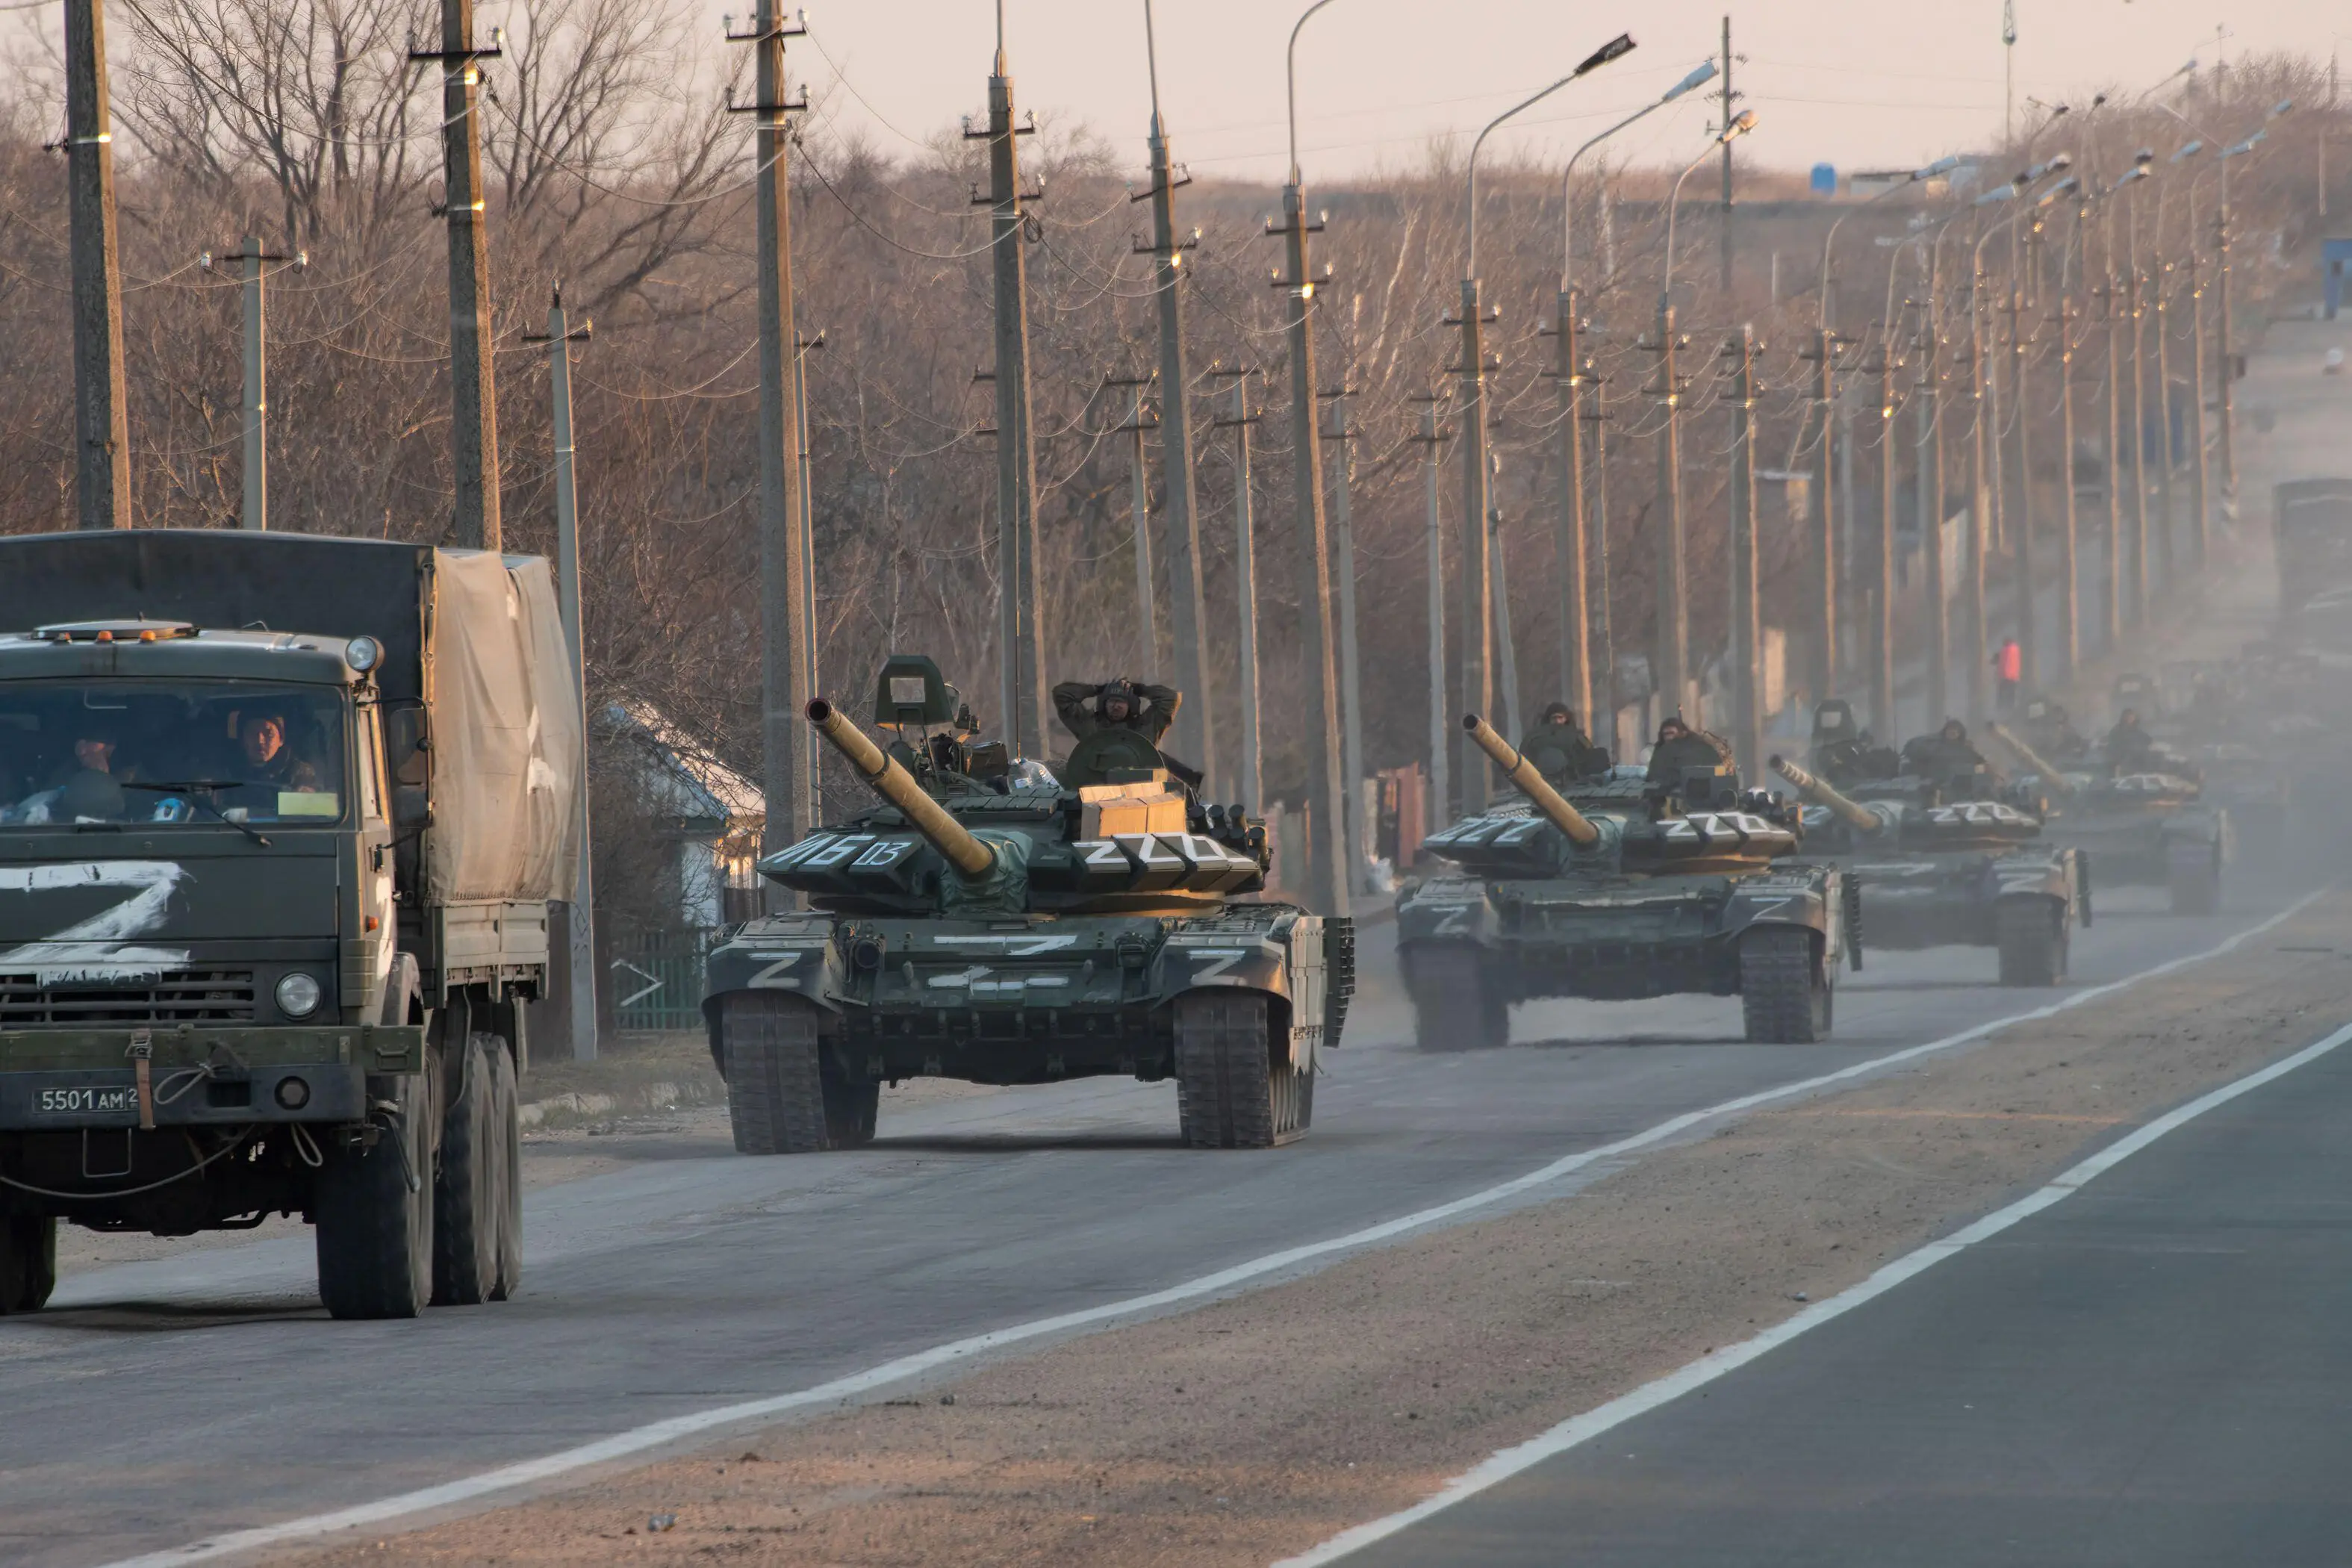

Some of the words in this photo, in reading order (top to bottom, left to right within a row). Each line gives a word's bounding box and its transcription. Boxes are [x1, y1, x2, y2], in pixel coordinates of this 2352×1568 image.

[0, 860, 192, 986] Z
[1431, 906, 1469, 935] Z
[1749, 897, 1791, 921] Z
[747, 952, 802, 989] Z
[1186, 950, 1248, 986] Z
